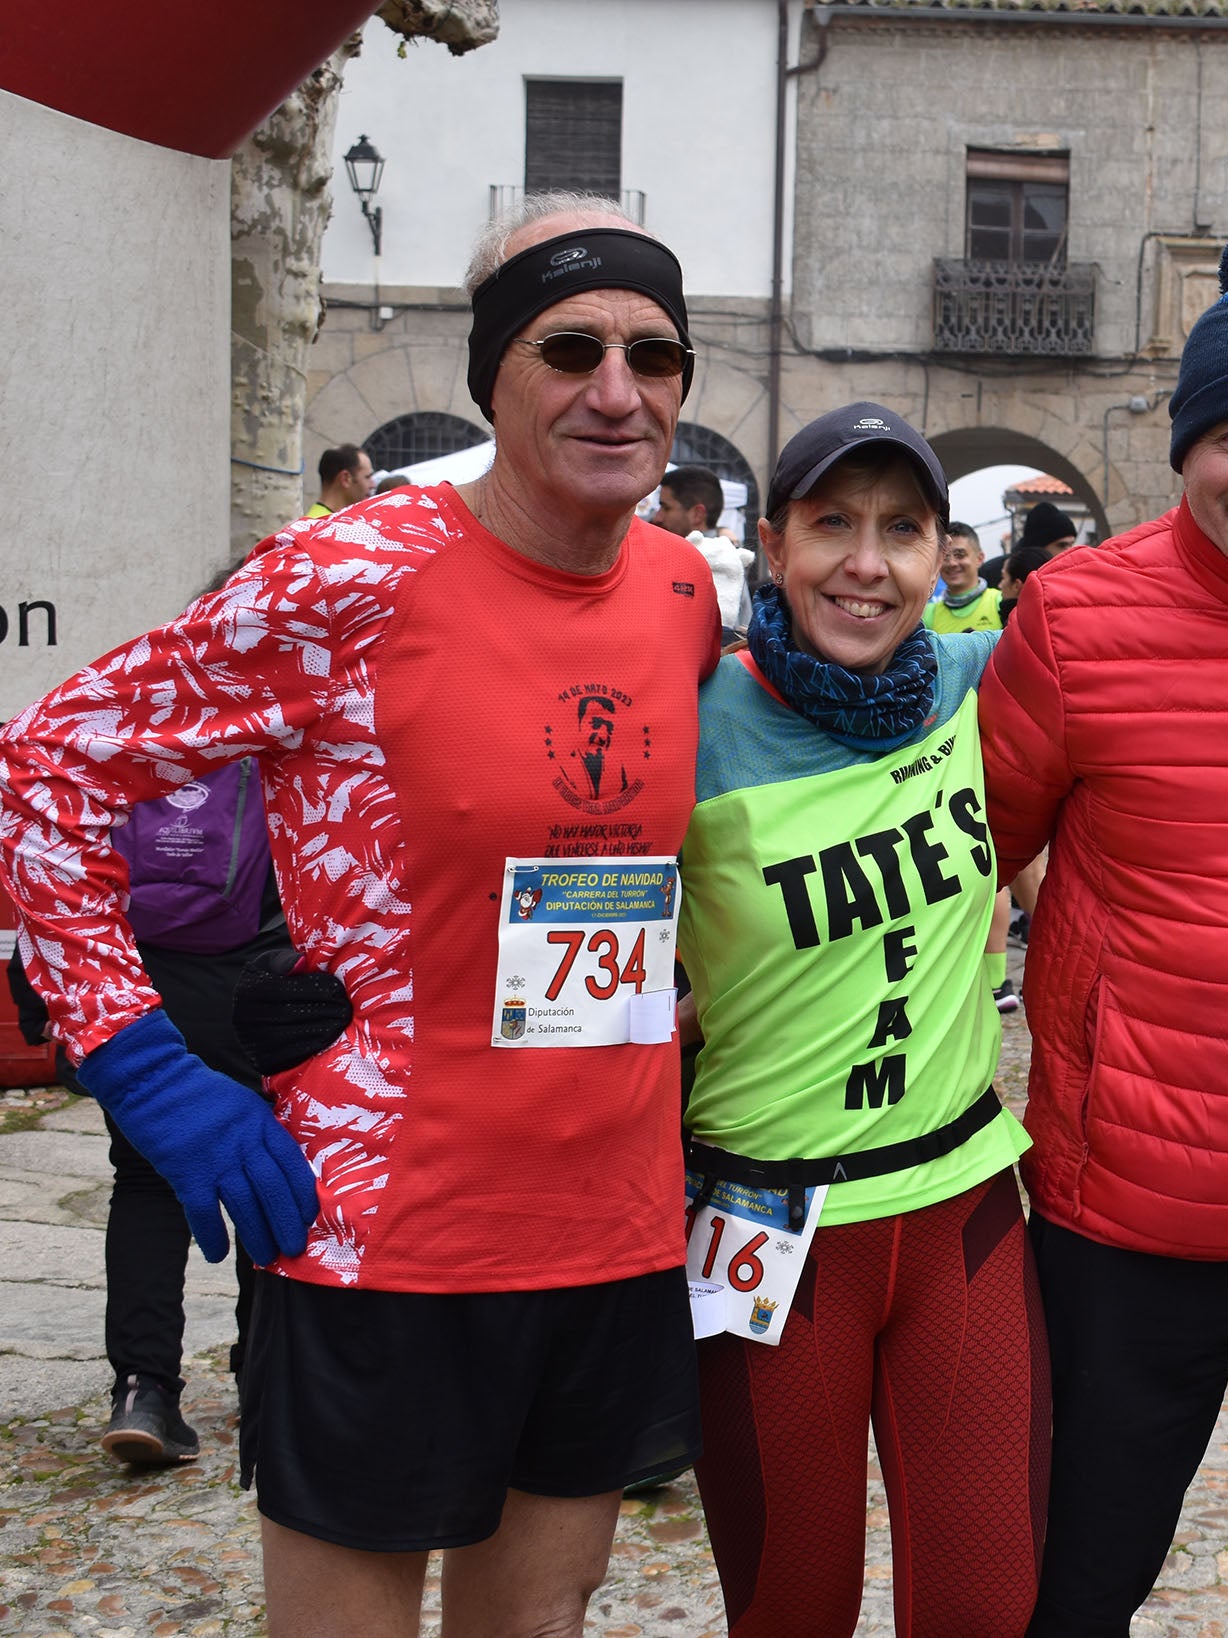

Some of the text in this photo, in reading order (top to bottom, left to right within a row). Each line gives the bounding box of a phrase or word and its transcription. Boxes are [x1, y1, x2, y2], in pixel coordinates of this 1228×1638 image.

[930, 755, 943, 765] &
[541, 873, 663, 887] TROFEO DE NAVIDAD
[546, 900, 655, 911] DIPUTACIÓN DE SALAMANCA
[545, 927, 647, 1001] 734
[528, 1007, 575, 1018] Diputación
[538, 1024, 582, 1034] Salamanca
[722, 1193, 773, 1215] SALAMANCA
